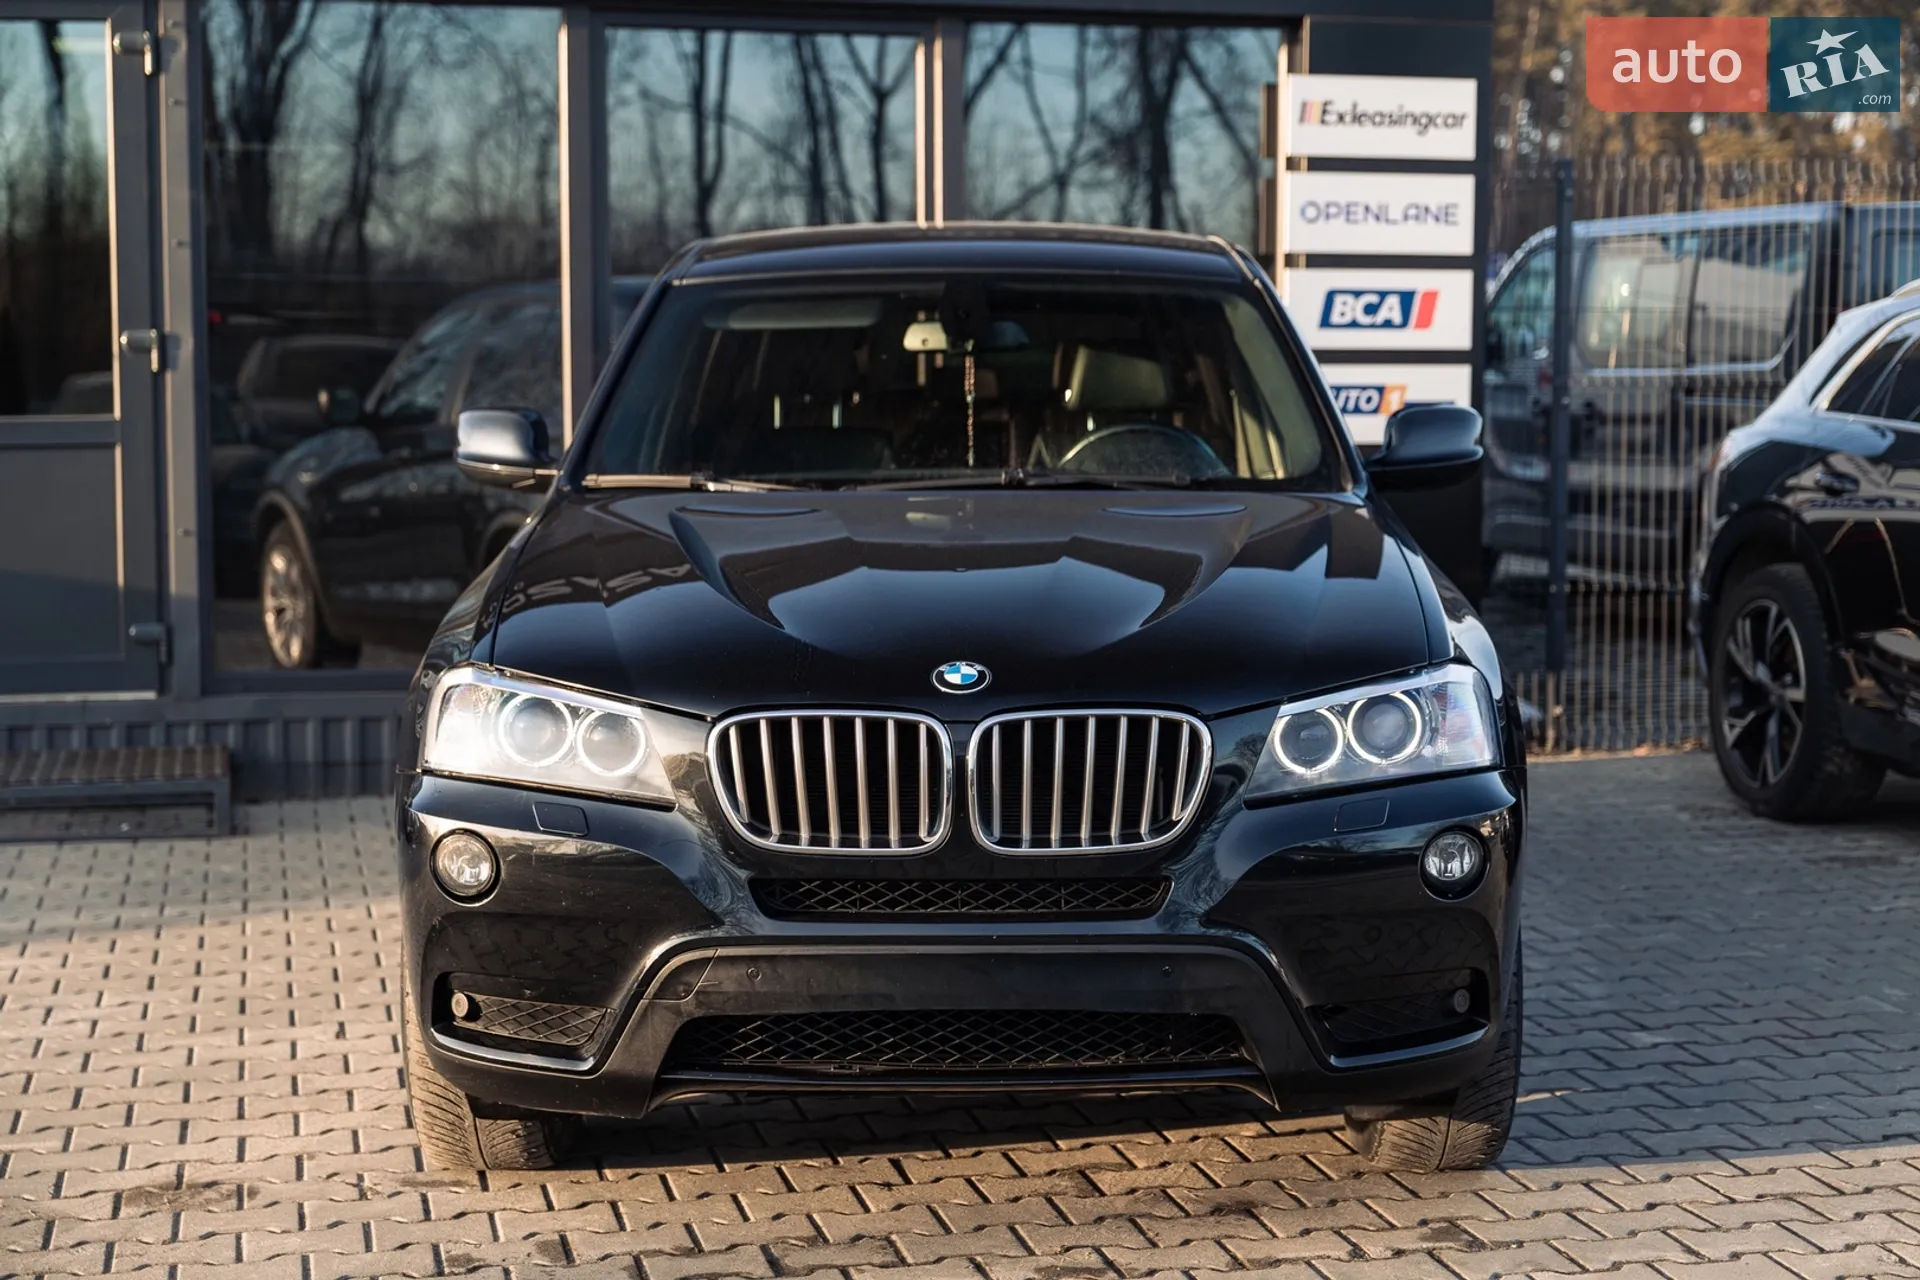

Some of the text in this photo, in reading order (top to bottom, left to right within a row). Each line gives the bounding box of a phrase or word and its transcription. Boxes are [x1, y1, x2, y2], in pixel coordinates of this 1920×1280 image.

[1320, 99, 1469, 136] Exleasingcar
[1299, 200, 1460, 227] OPENLANE
[1328, 292, 1404, 326] BCA
[1330, 387, 1402, 412] UTO1
